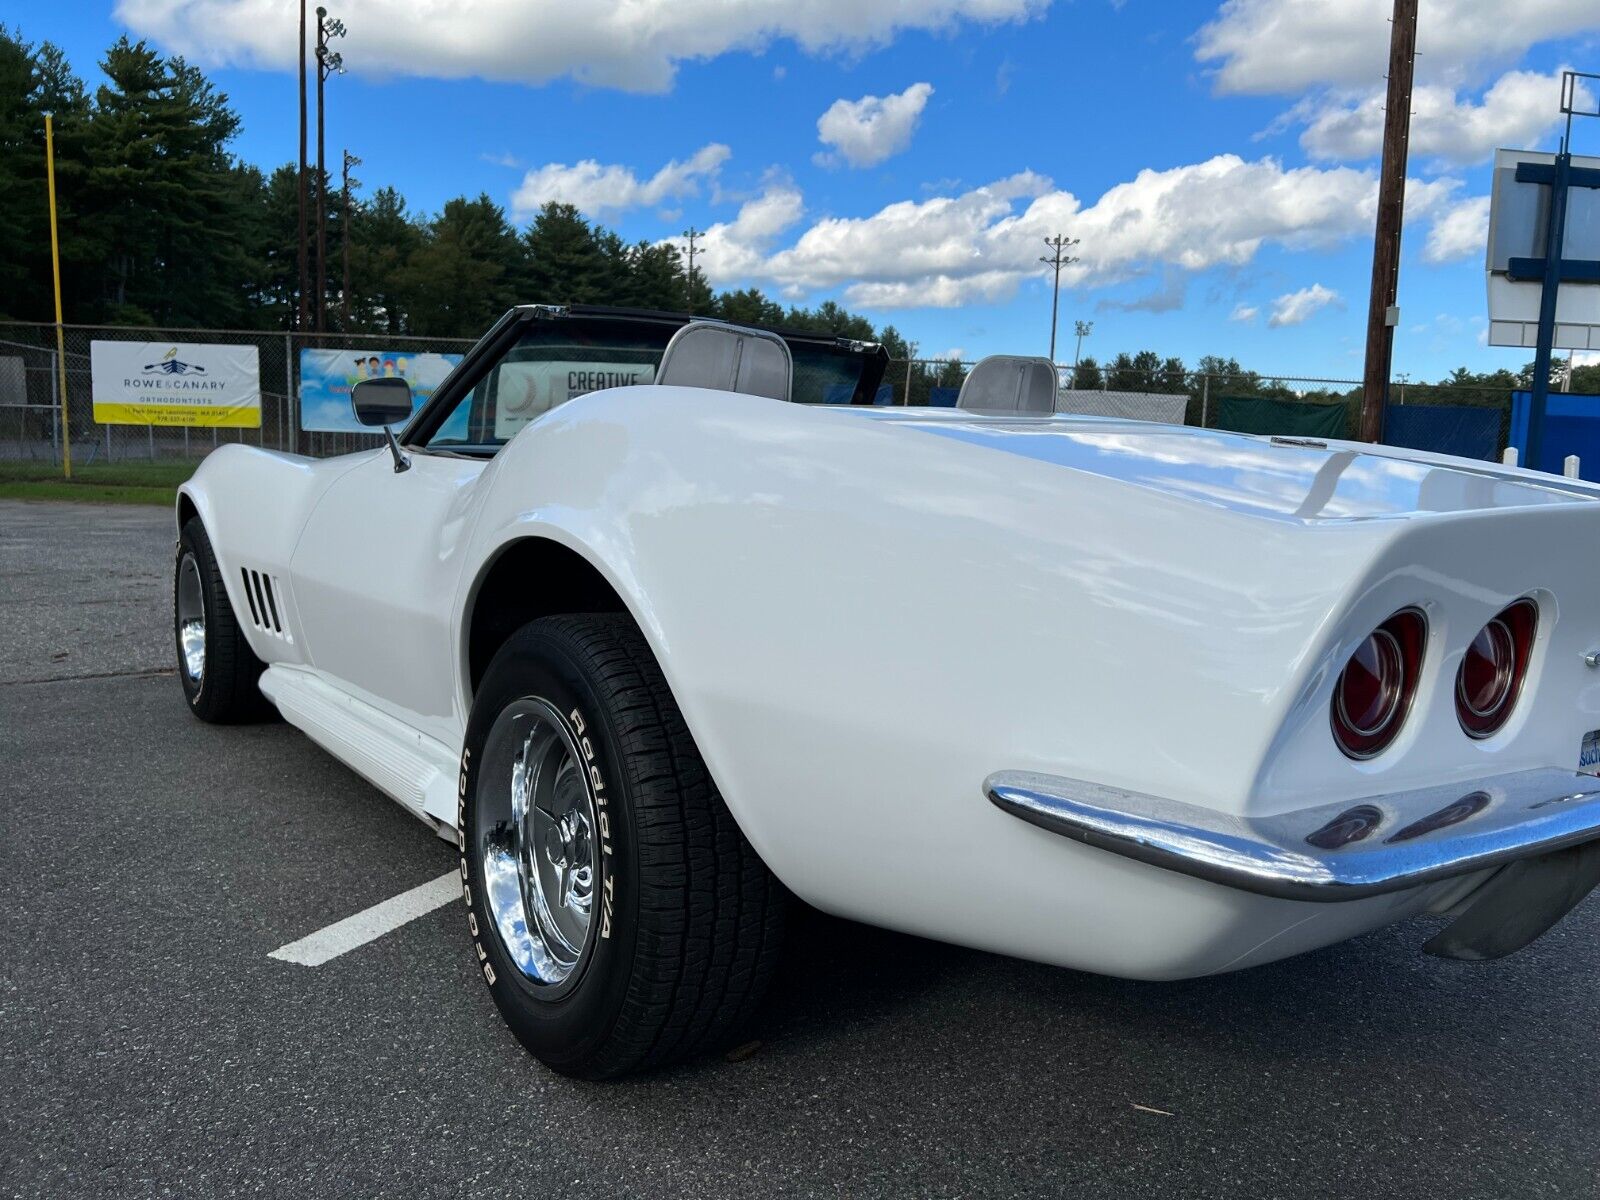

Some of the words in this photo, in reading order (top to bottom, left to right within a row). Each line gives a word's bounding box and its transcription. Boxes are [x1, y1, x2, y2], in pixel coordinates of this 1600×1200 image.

[568, 371, 639, 390] CREATIVE
[139, 396, 213, 405] ORTHODONTISTS
[569, 708, 613, 855] Radial
[601, 874, 614, 939] T/A
